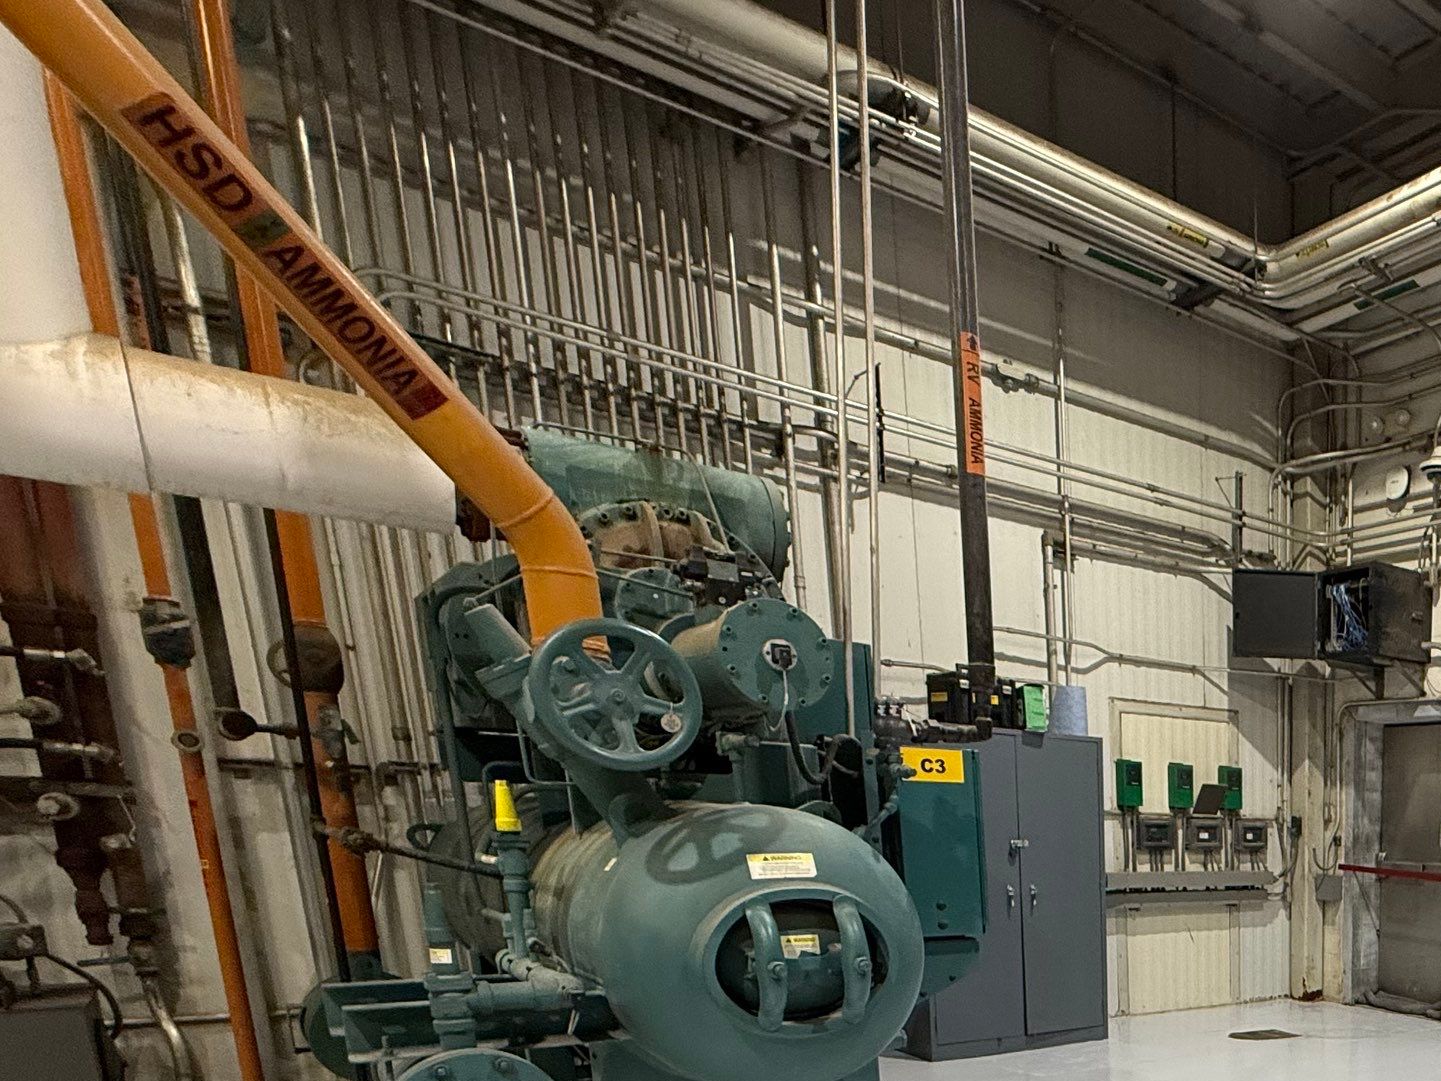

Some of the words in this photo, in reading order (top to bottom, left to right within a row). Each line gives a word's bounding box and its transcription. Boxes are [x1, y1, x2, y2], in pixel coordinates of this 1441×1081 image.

[137, 104, 254, 213] HSD
[264, 244, 421, 398] AMMONIA
[966, 360, 981, 388] RV
[968, 397, 985, 464] AMMONIA
[920, 757, 947, 774] C3
